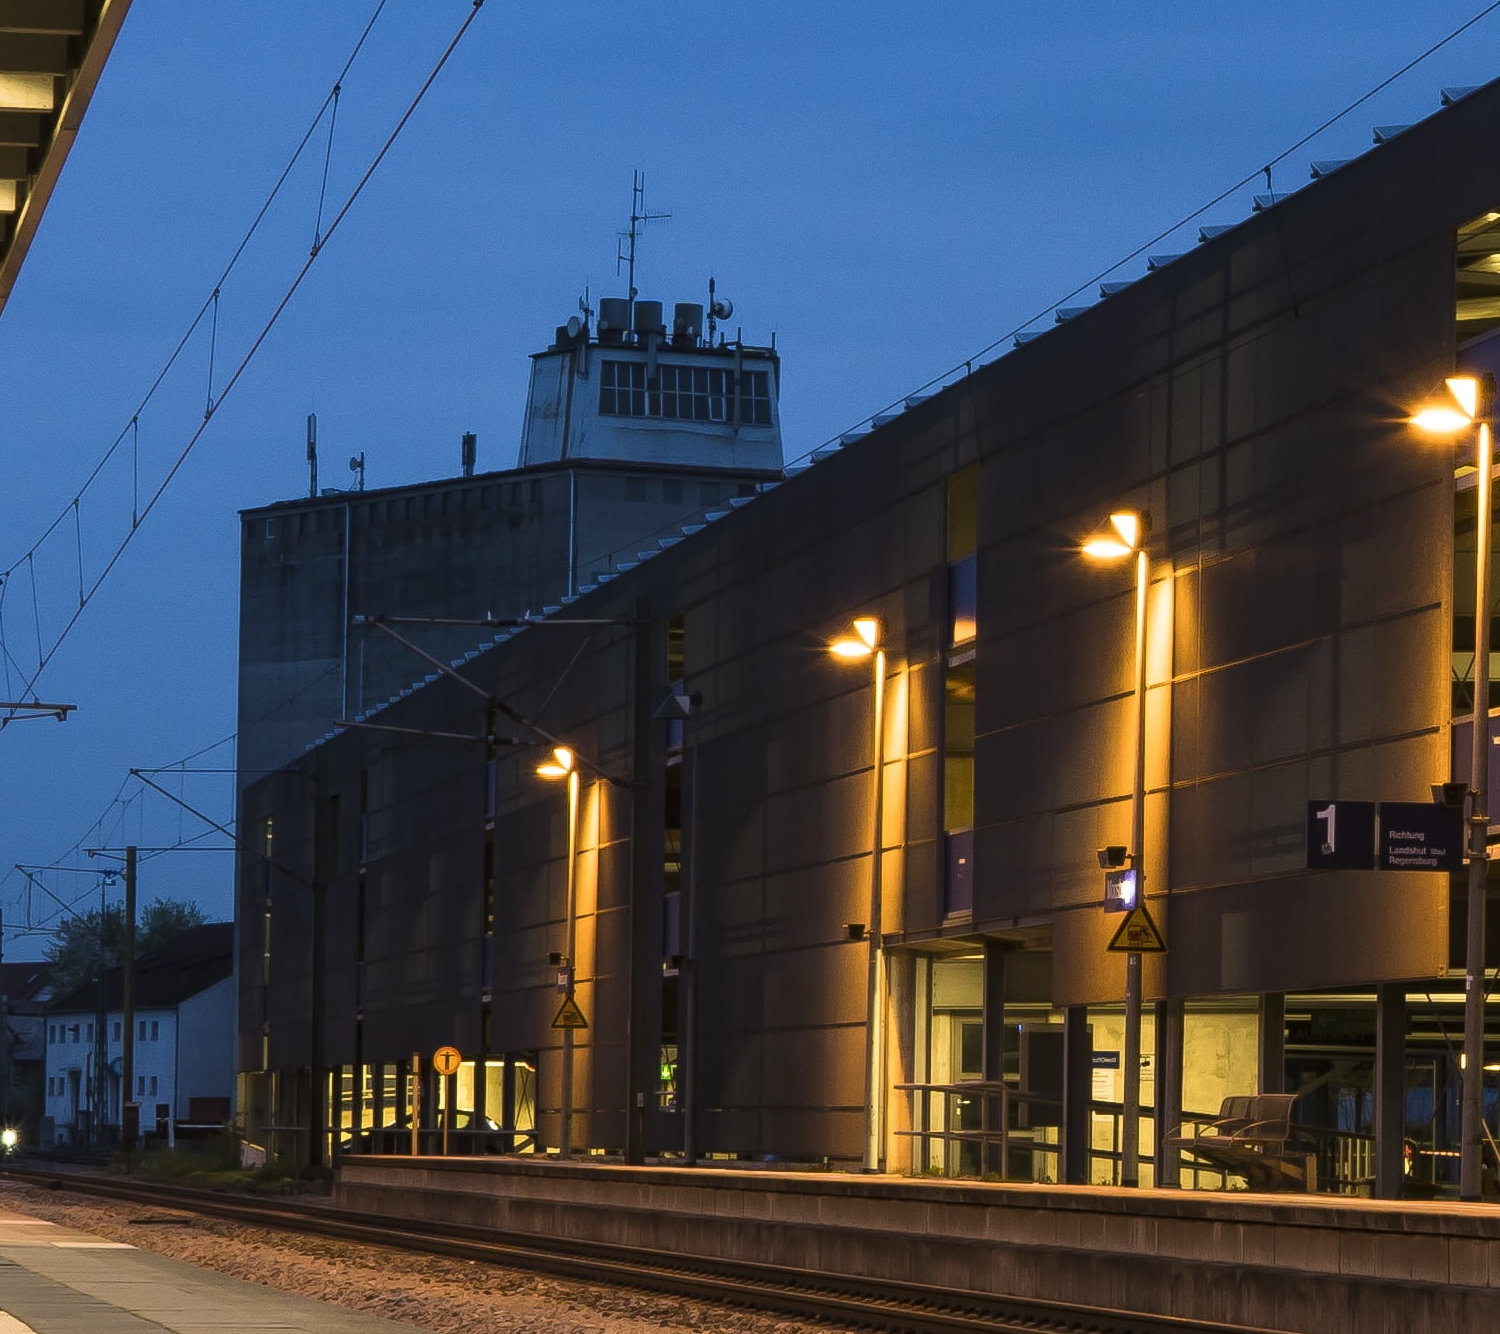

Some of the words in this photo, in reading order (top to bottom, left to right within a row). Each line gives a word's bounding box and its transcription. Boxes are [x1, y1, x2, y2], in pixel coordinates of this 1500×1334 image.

[1316, 803, 1337, 853] 1
[1389, 830, 1425, 842] Richtung
[1389, 845, 1427, 855] Landshut
[1389, 856, 1438, 867] Regensburg
